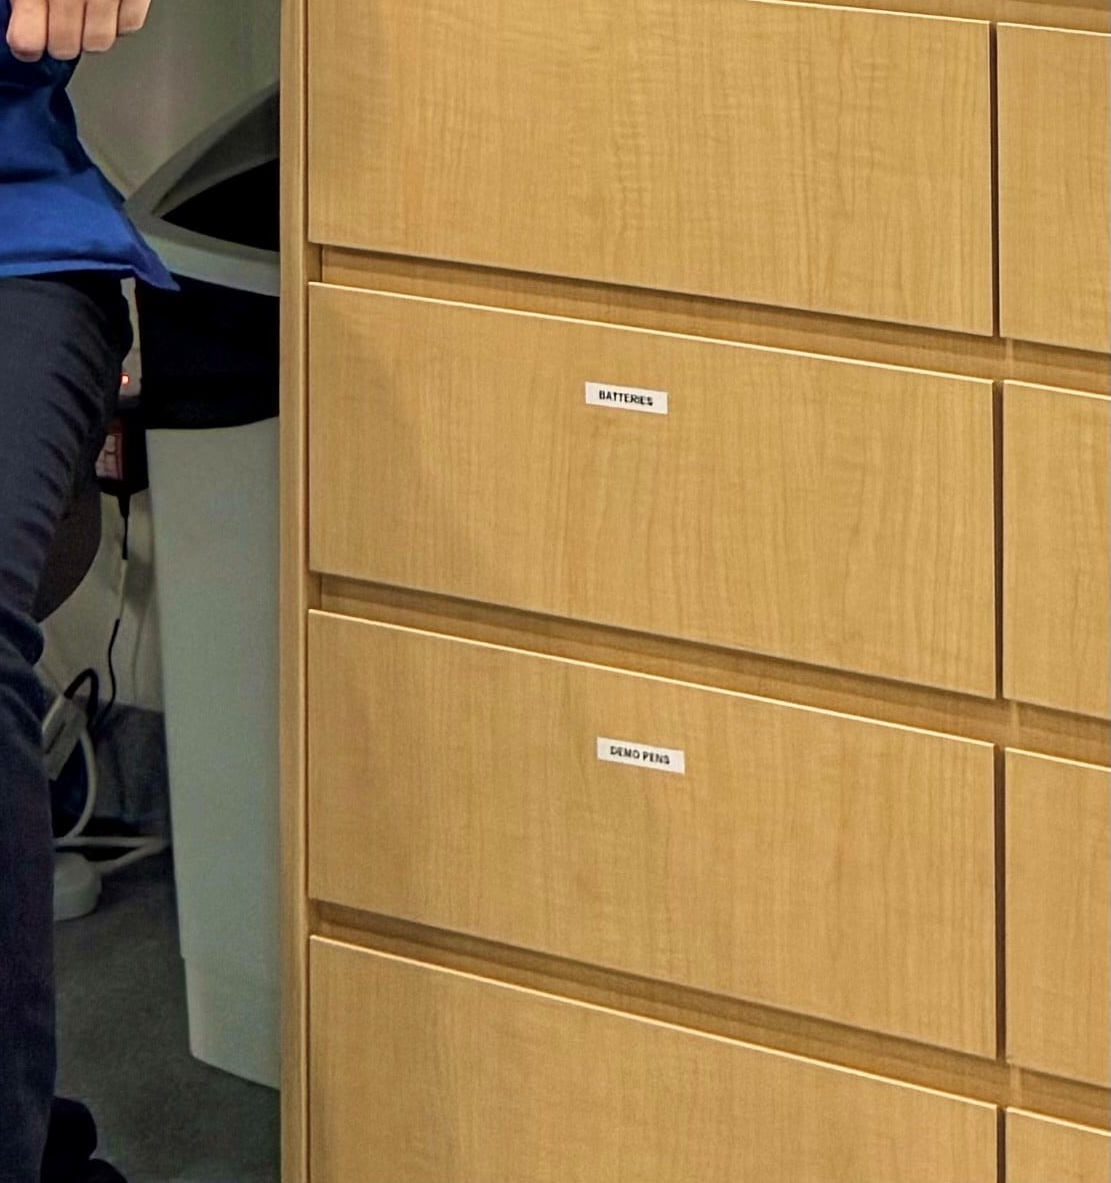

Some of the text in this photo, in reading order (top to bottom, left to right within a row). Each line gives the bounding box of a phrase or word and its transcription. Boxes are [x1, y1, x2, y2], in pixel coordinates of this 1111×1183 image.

[598, 389, 653, 406] BATTERIES
[609, 745, 670, 765] DEMO PENS
